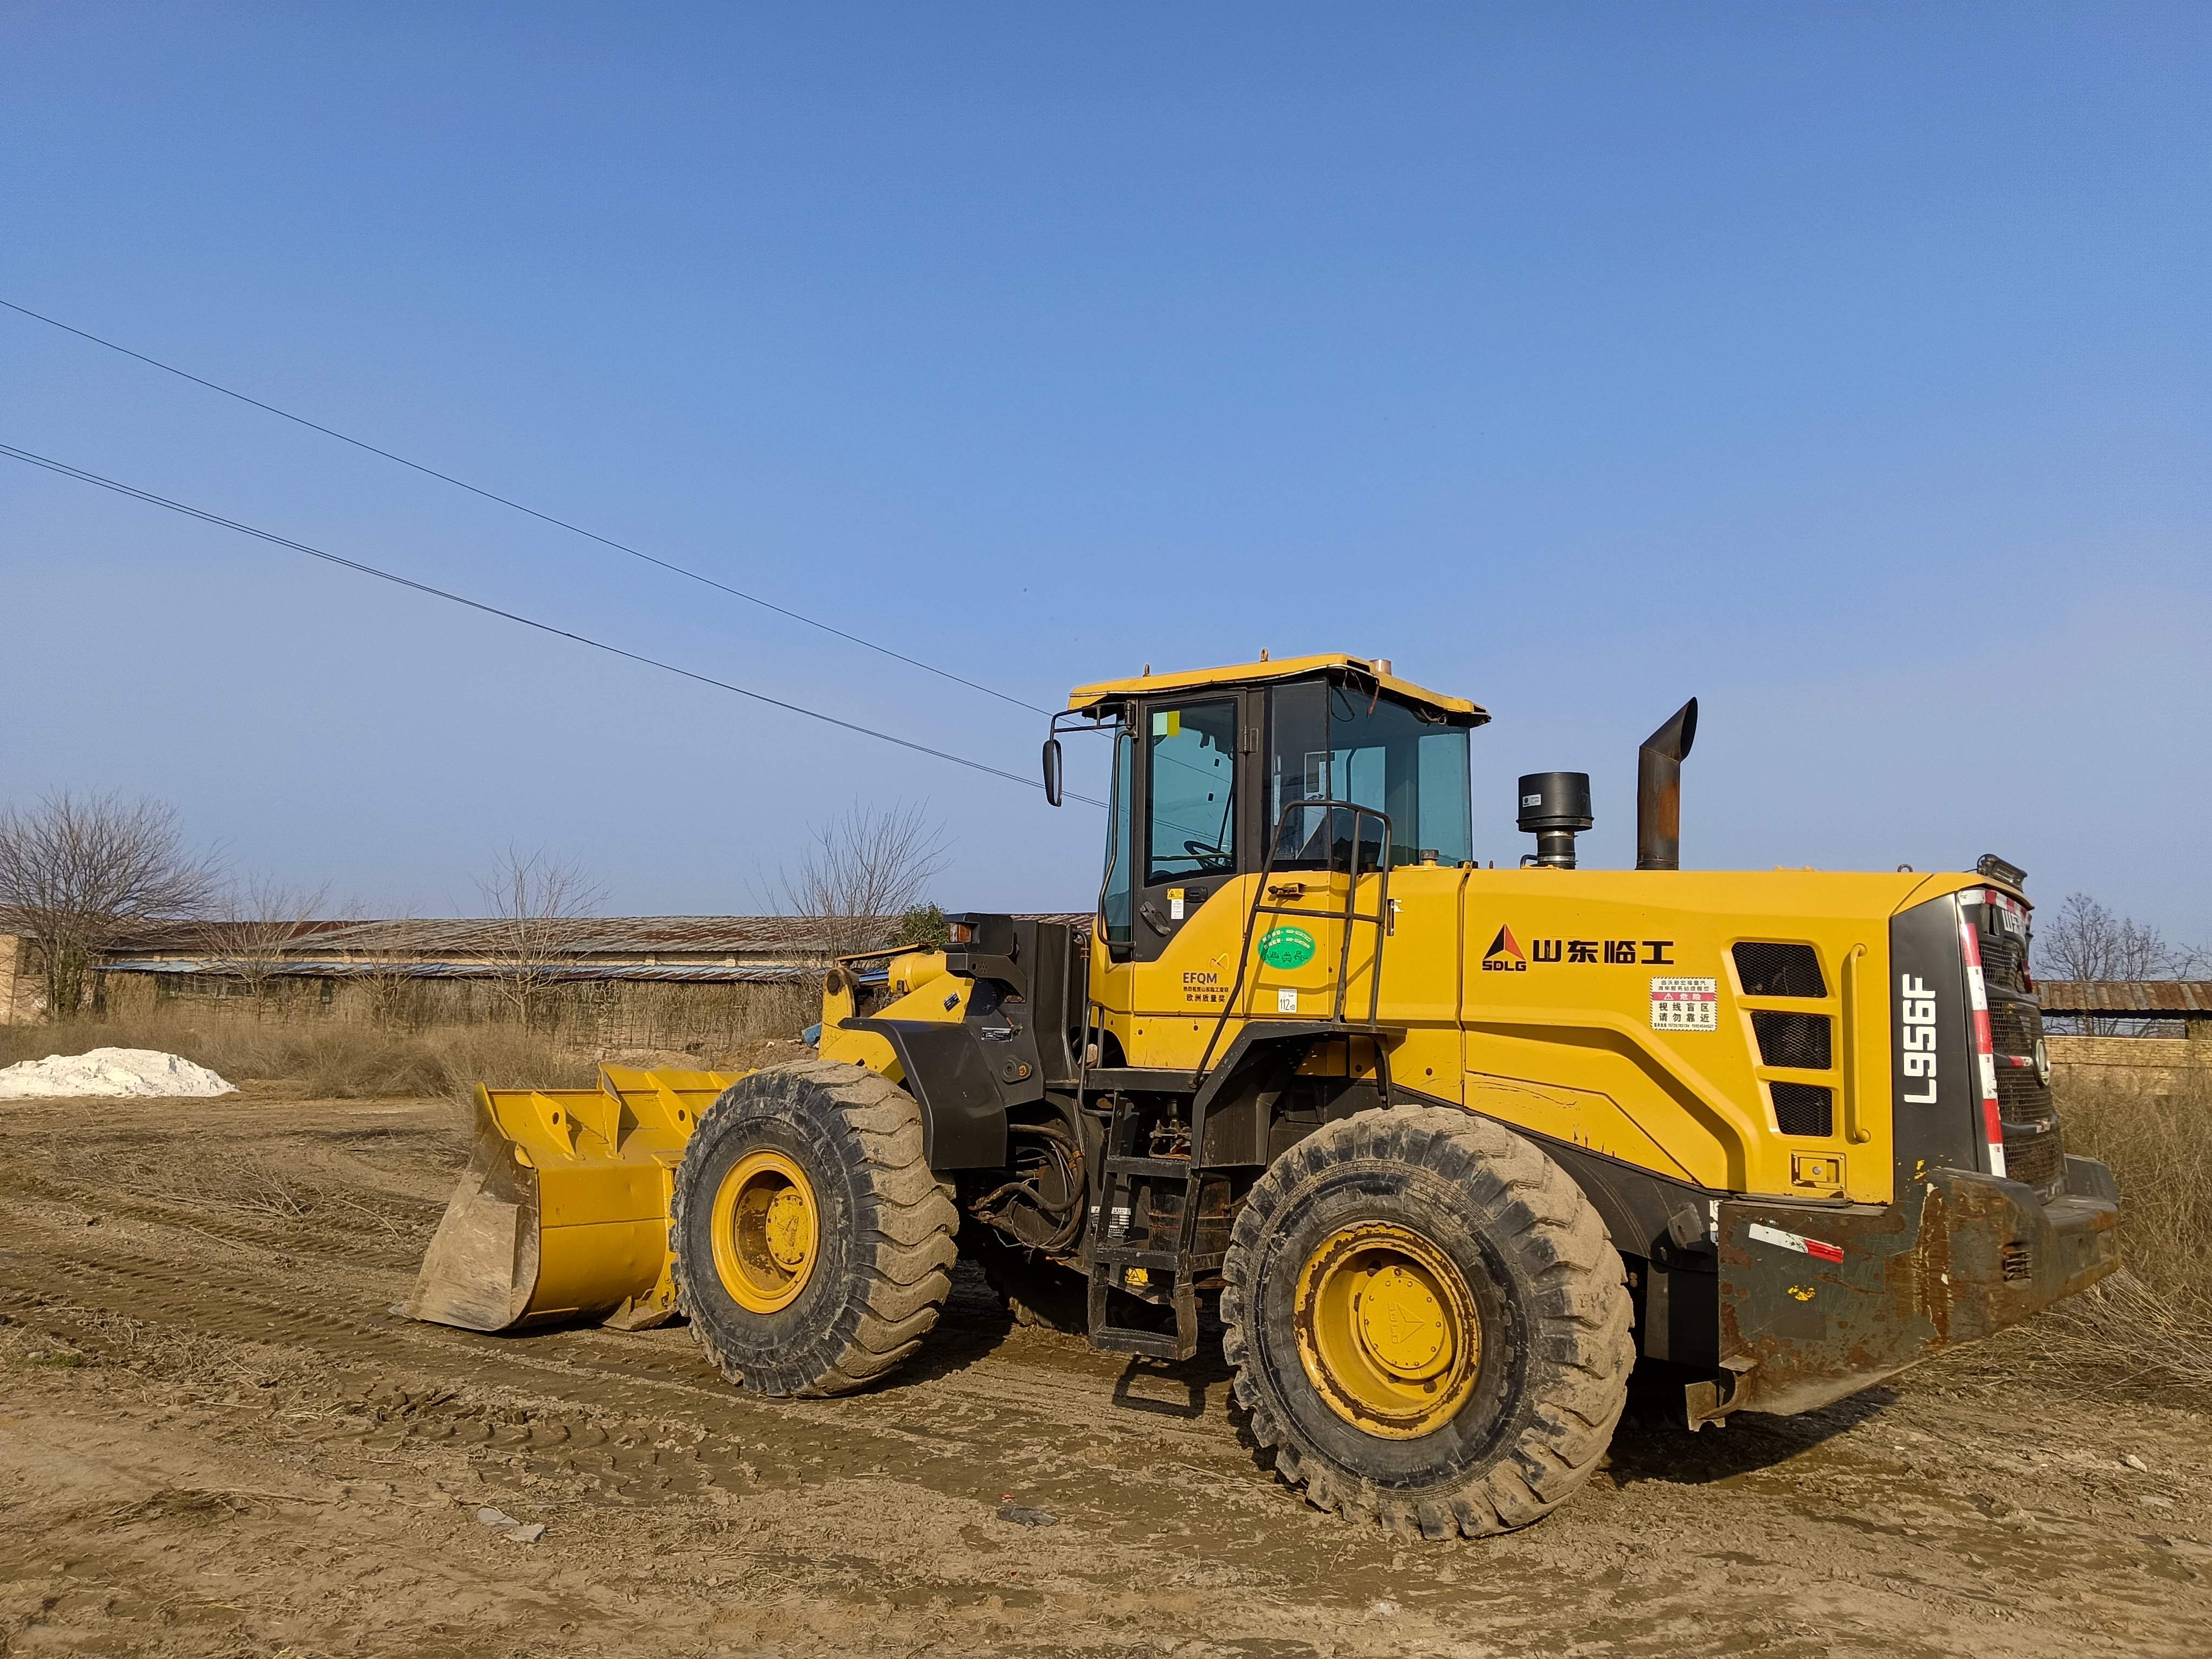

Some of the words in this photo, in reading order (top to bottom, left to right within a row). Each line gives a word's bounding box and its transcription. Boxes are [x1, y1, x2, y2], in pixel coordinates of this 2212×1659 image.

[1533, 940, 1674, 965] 山东临工
[1482, 960, 1526, 972] SDLG
[1183, 972, 1217, 985] EFQM
[1186, 993, 1225, 1002] 欧洲质量奖
[1680, 993, 1702, 1001] 危险
[1658, 1002, 1709, 1012] 视线盲区
[1658, 1012, 1709, 1023] 请勿靠近
[1902, 974, 1937, 1104] L956F
